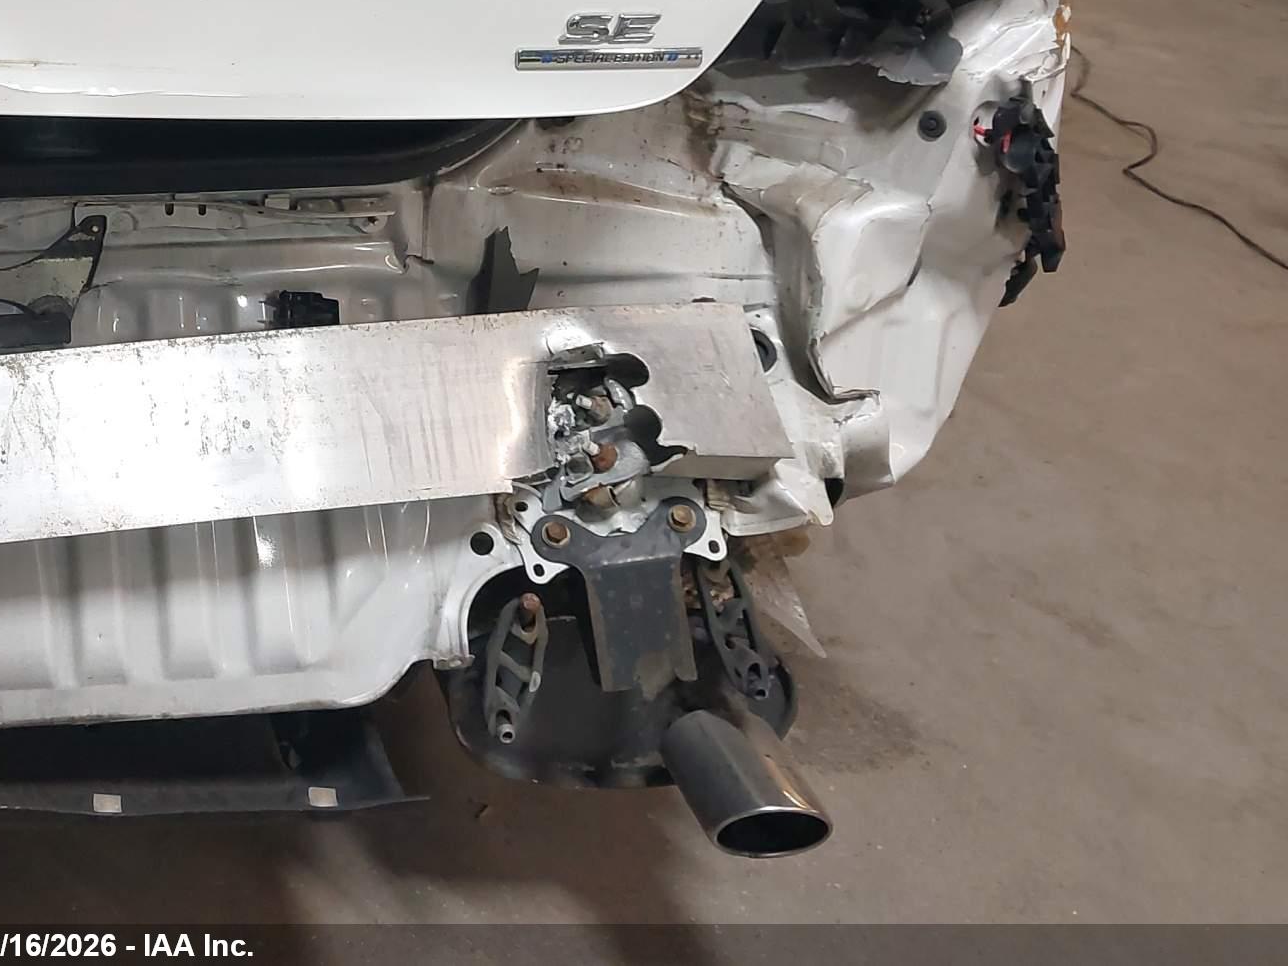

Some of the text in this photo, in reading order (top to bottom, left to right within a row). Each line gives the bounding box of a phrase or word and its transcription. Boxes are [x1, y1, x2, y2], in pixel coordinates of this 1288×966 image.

[558, 13, 662, 45] SE
[555, 51, 665, 64] SPECIAL EDITION
